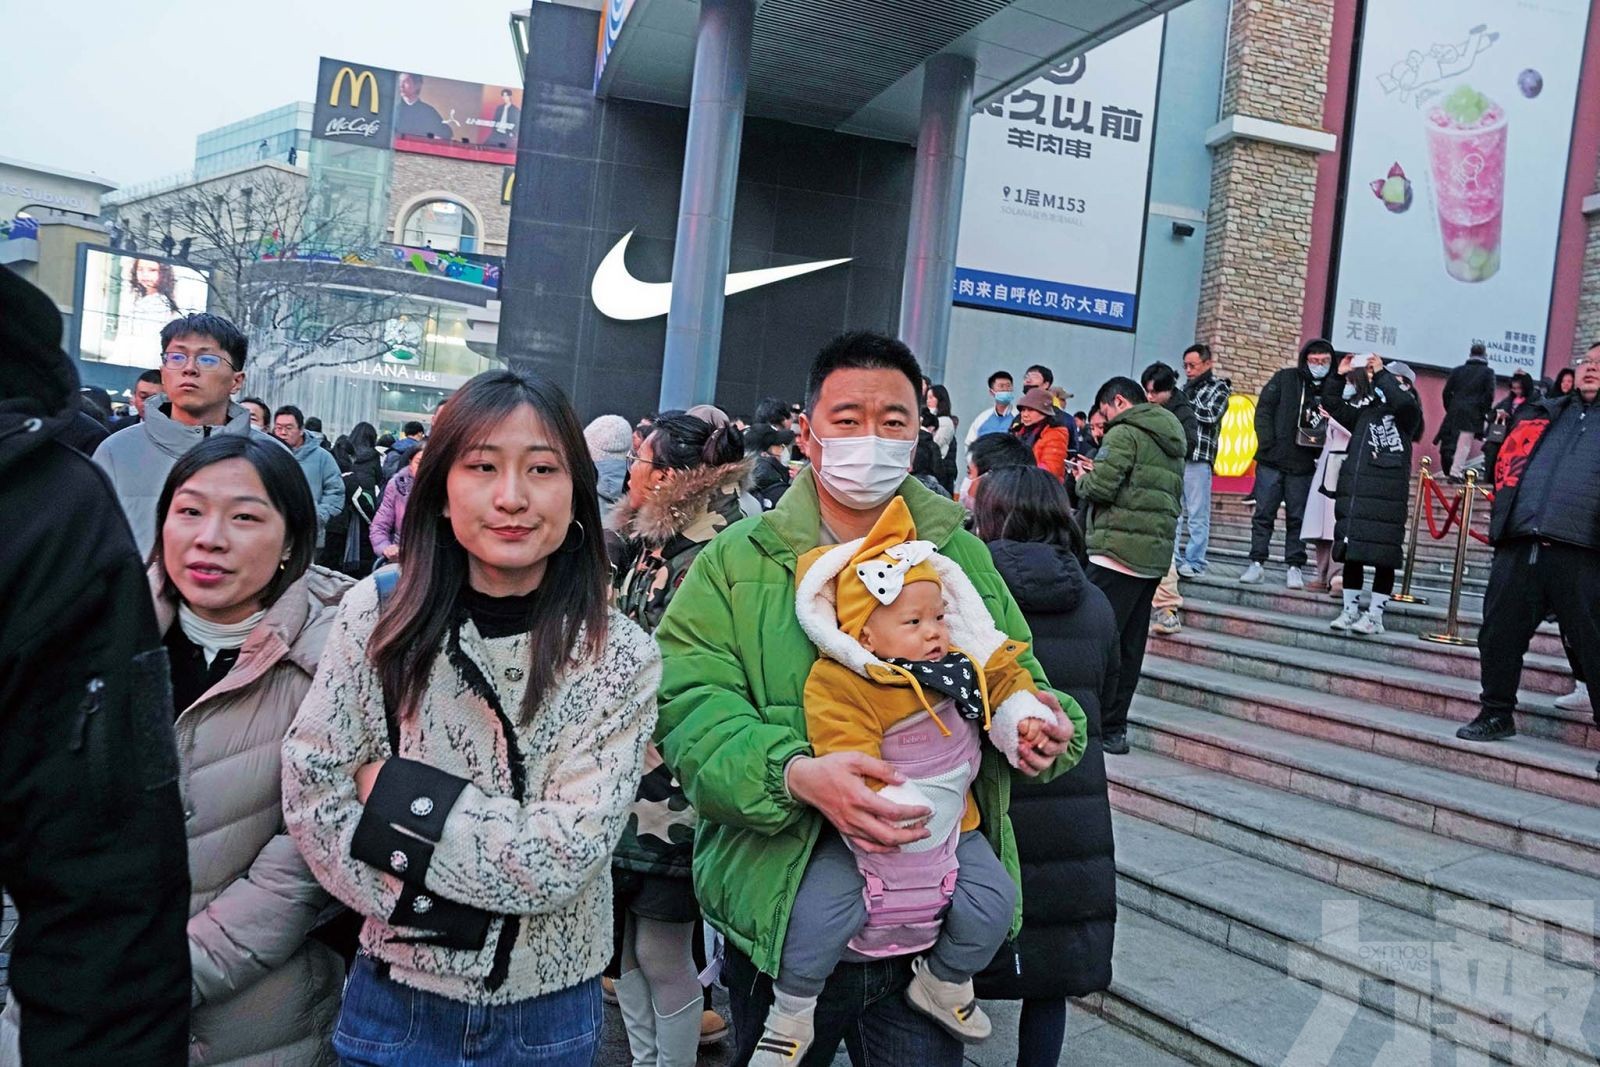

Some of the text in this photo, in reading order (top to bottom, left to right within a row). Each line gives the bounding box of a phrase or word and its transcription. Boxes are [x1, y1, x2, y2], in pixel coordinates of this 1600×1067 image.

[325, 117, 380, 137] McCafé
[1007, 127, 1092, 160] 羊肉串
[1348, 298, 1383, 321] 真果
[1346, 321, 1398, 346] 无香精
[414, 370, 436, 382] kids
